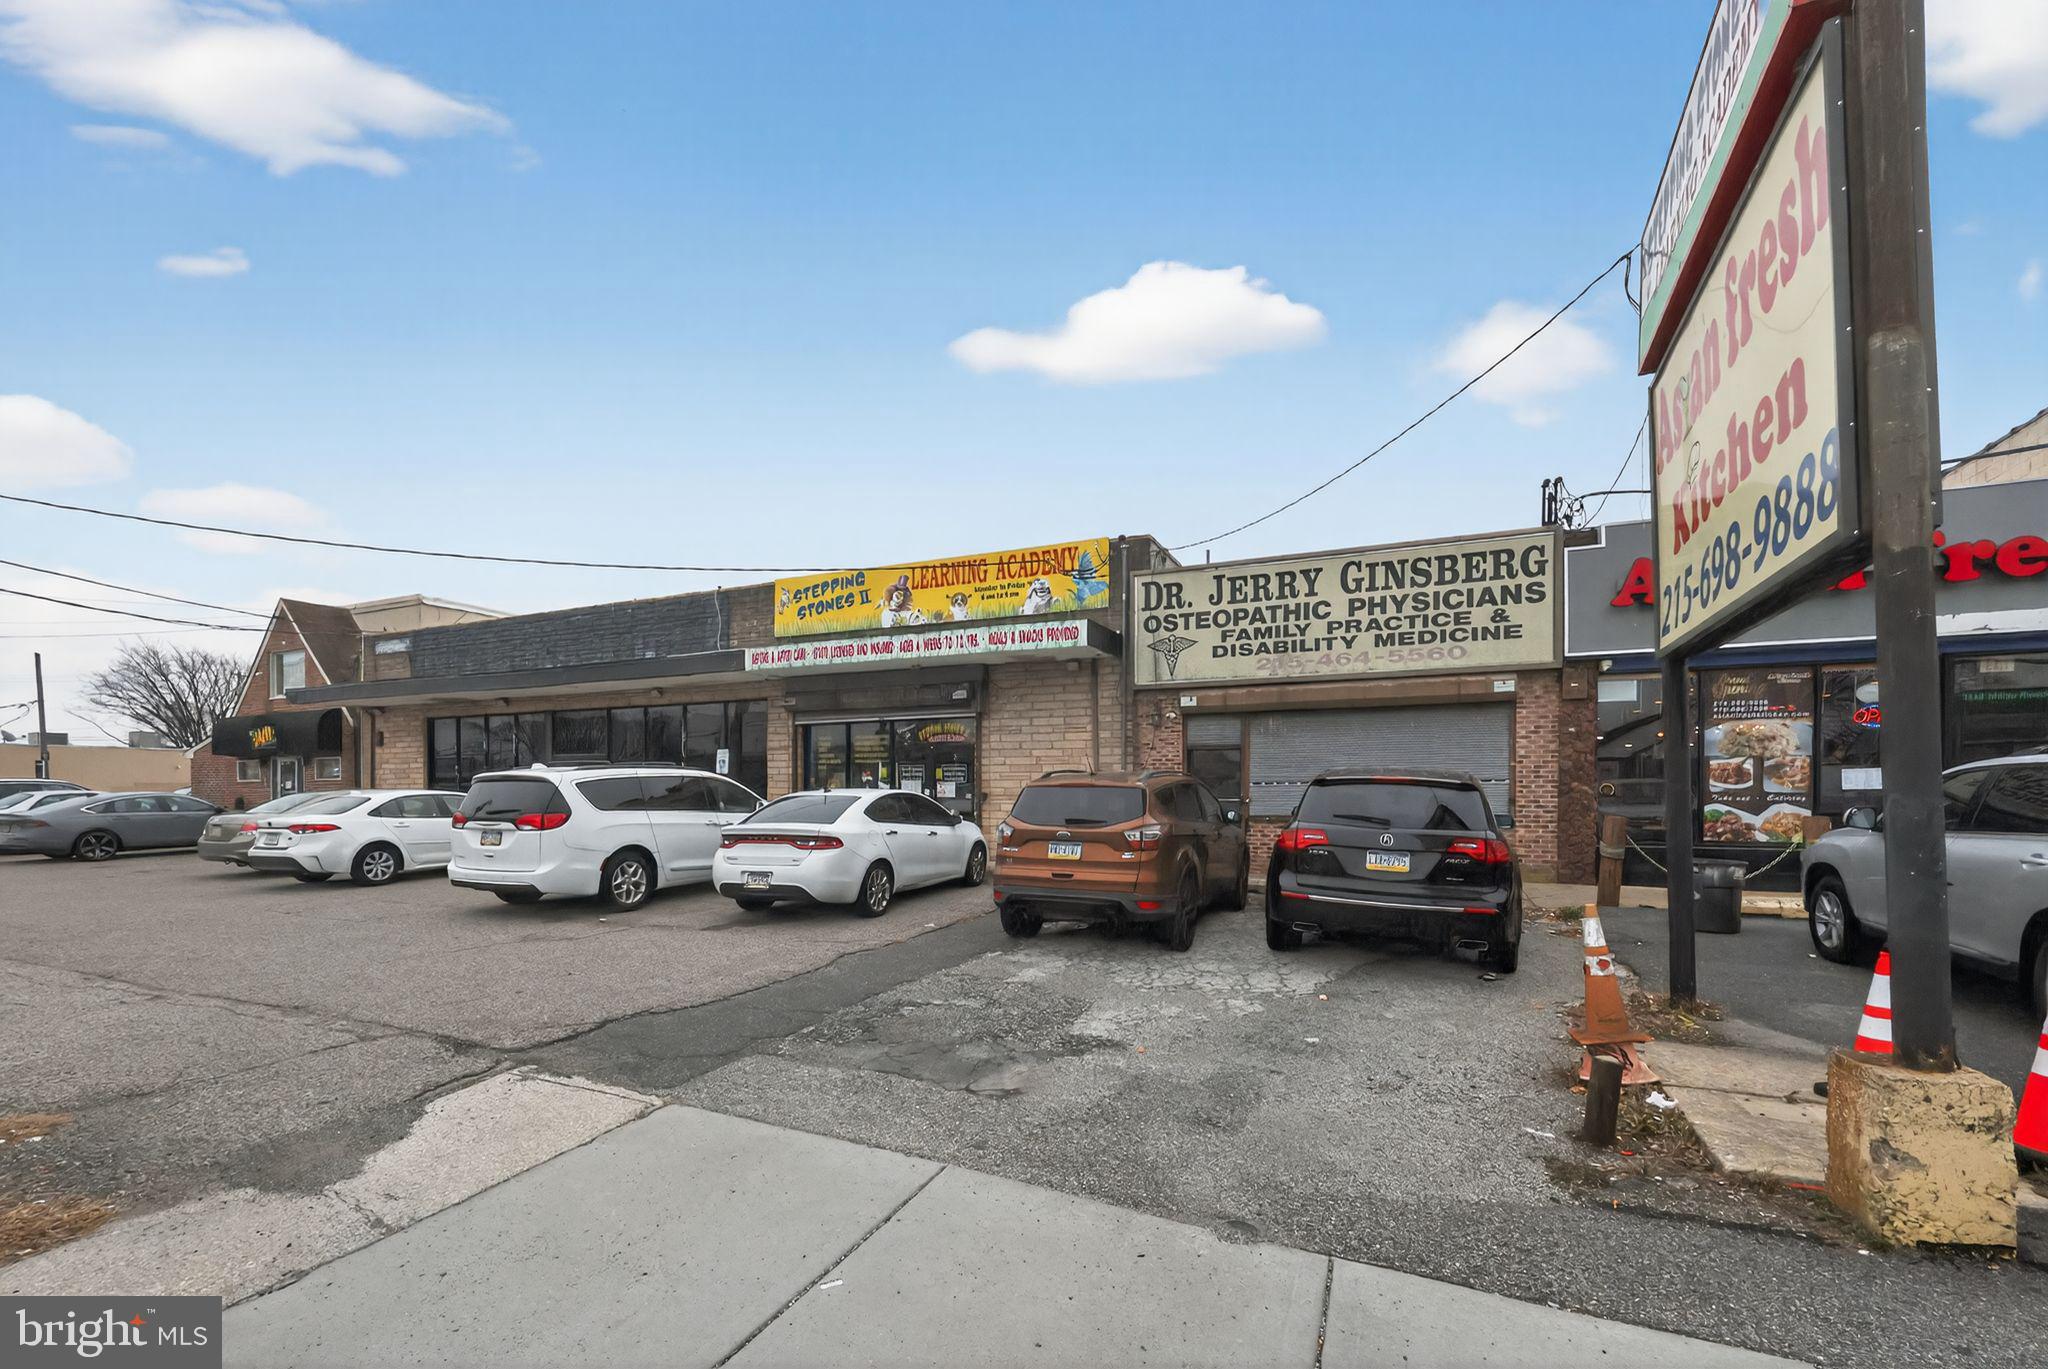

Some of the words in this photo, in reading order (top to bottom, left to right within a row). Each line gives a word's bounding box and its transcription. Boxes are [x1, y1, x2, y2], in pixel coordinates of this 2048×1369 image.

[1725, 115, 1830, 369] fresh
[1673, 357, 1808, 555] Kitchen
[1661, 427, 1839, 638] 215-698-9888
[793, 571, 865, 604] STEPPING
[911, 558, 988, 590] LEARNING
[996, 546, 1079, 581] ACADEMY
[1141, 581, 1193, 612] DR.
[1209, 567, 1323, 606] JERRY
[1340, 544, 1549, 594] GINSBERG
[797, 592, 855, 620] STONES
[859, 588, 872, 605] II
[1143, 600, 1331, 633] OSTEOPATHIC
[1348, 581, 1546, 617] PHYSICIANS
[1221, 623, 1312, 643] FAMILY
[1327, 611, 1472, 635] PRACTICE
[1490, 608, 1511, 623] &
[1212, 635, 1358, 658] DISABILITY
[1374, 624, 1523, 647] MEDICINE
[1853, 708, 1881, 723] OP
